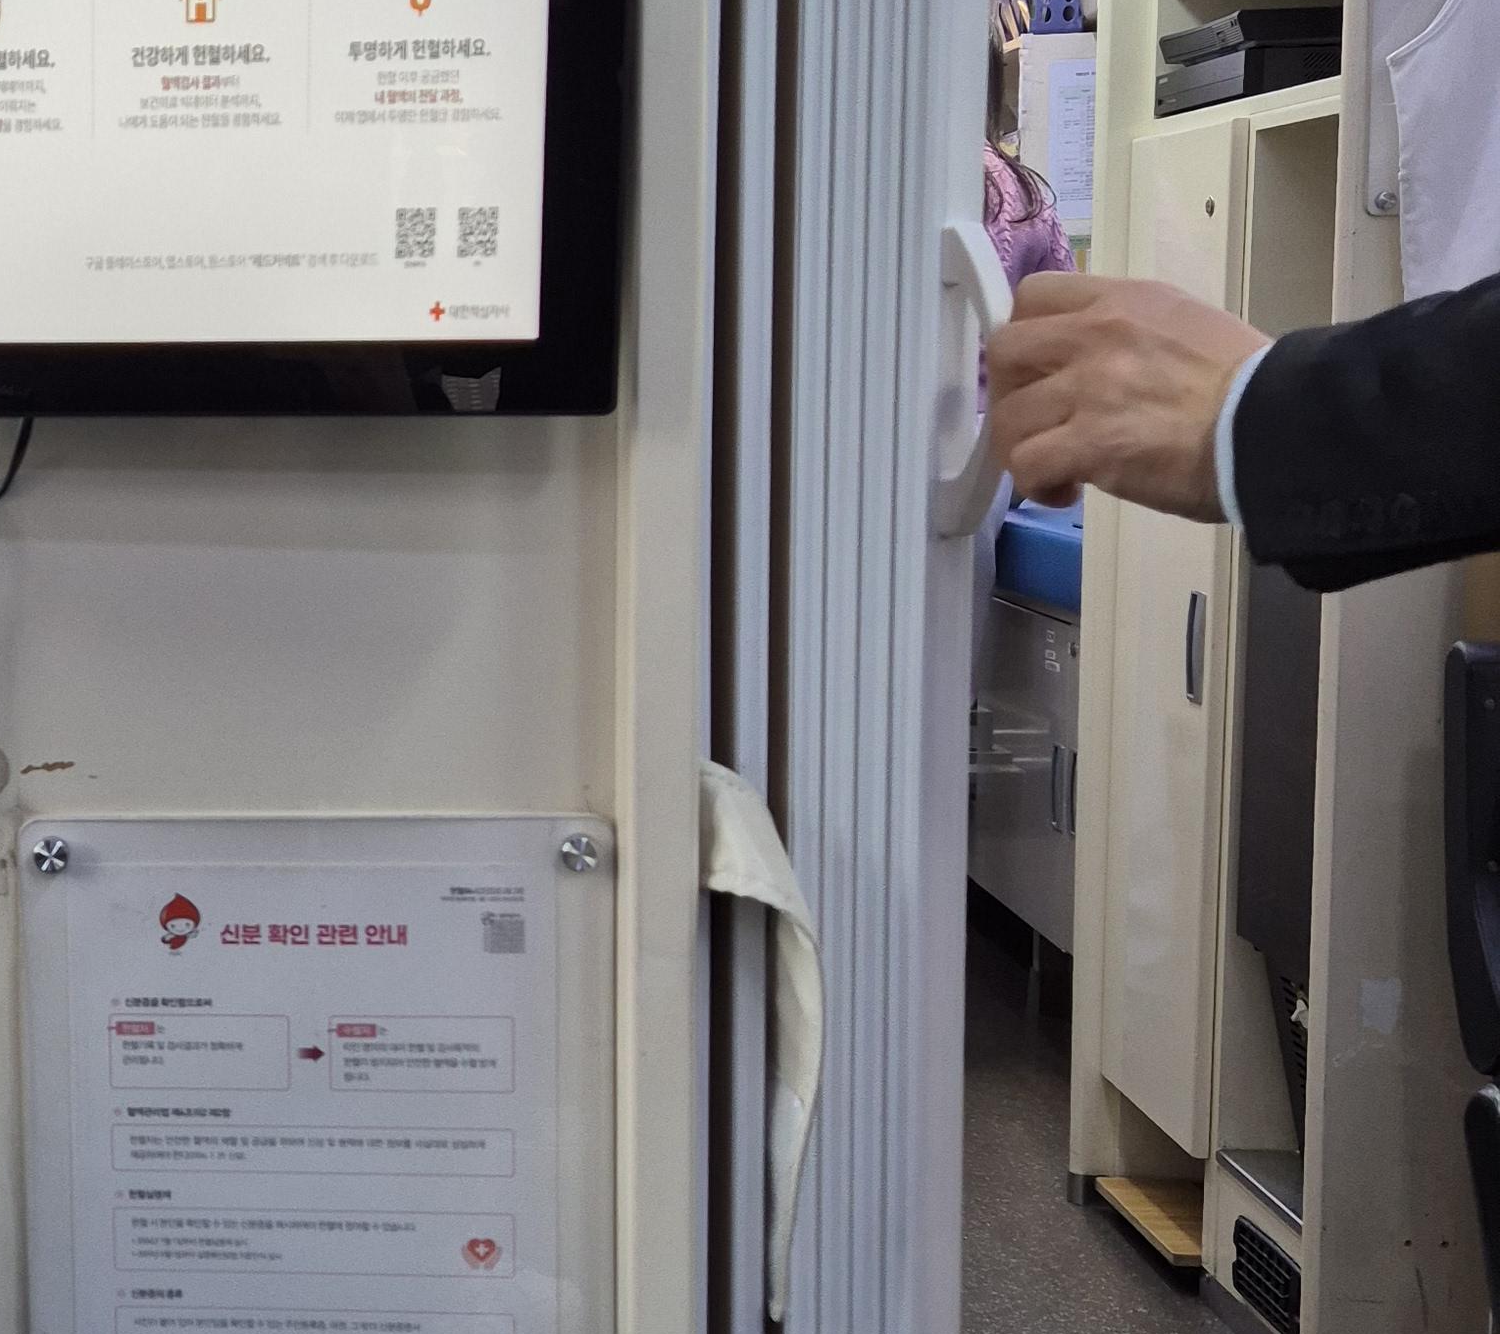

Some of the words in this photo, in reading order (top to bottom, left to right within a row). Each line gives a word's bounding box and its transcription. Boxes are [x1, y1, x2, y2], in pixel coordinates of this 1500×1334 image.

[131, 44, 189, 67] 건강하게
[192, 42, 271, 66] 헌혈하세요.
[348, 39, 408, 62] 투명하게
[411, 38, 493, 60] 헌혈하세요.
[220, 924, 262, 946] 신분
[267, 924, 310, 946] 확인
[315, 923, 359, 946] 관련
[364, 923, 408, 946] 안내
